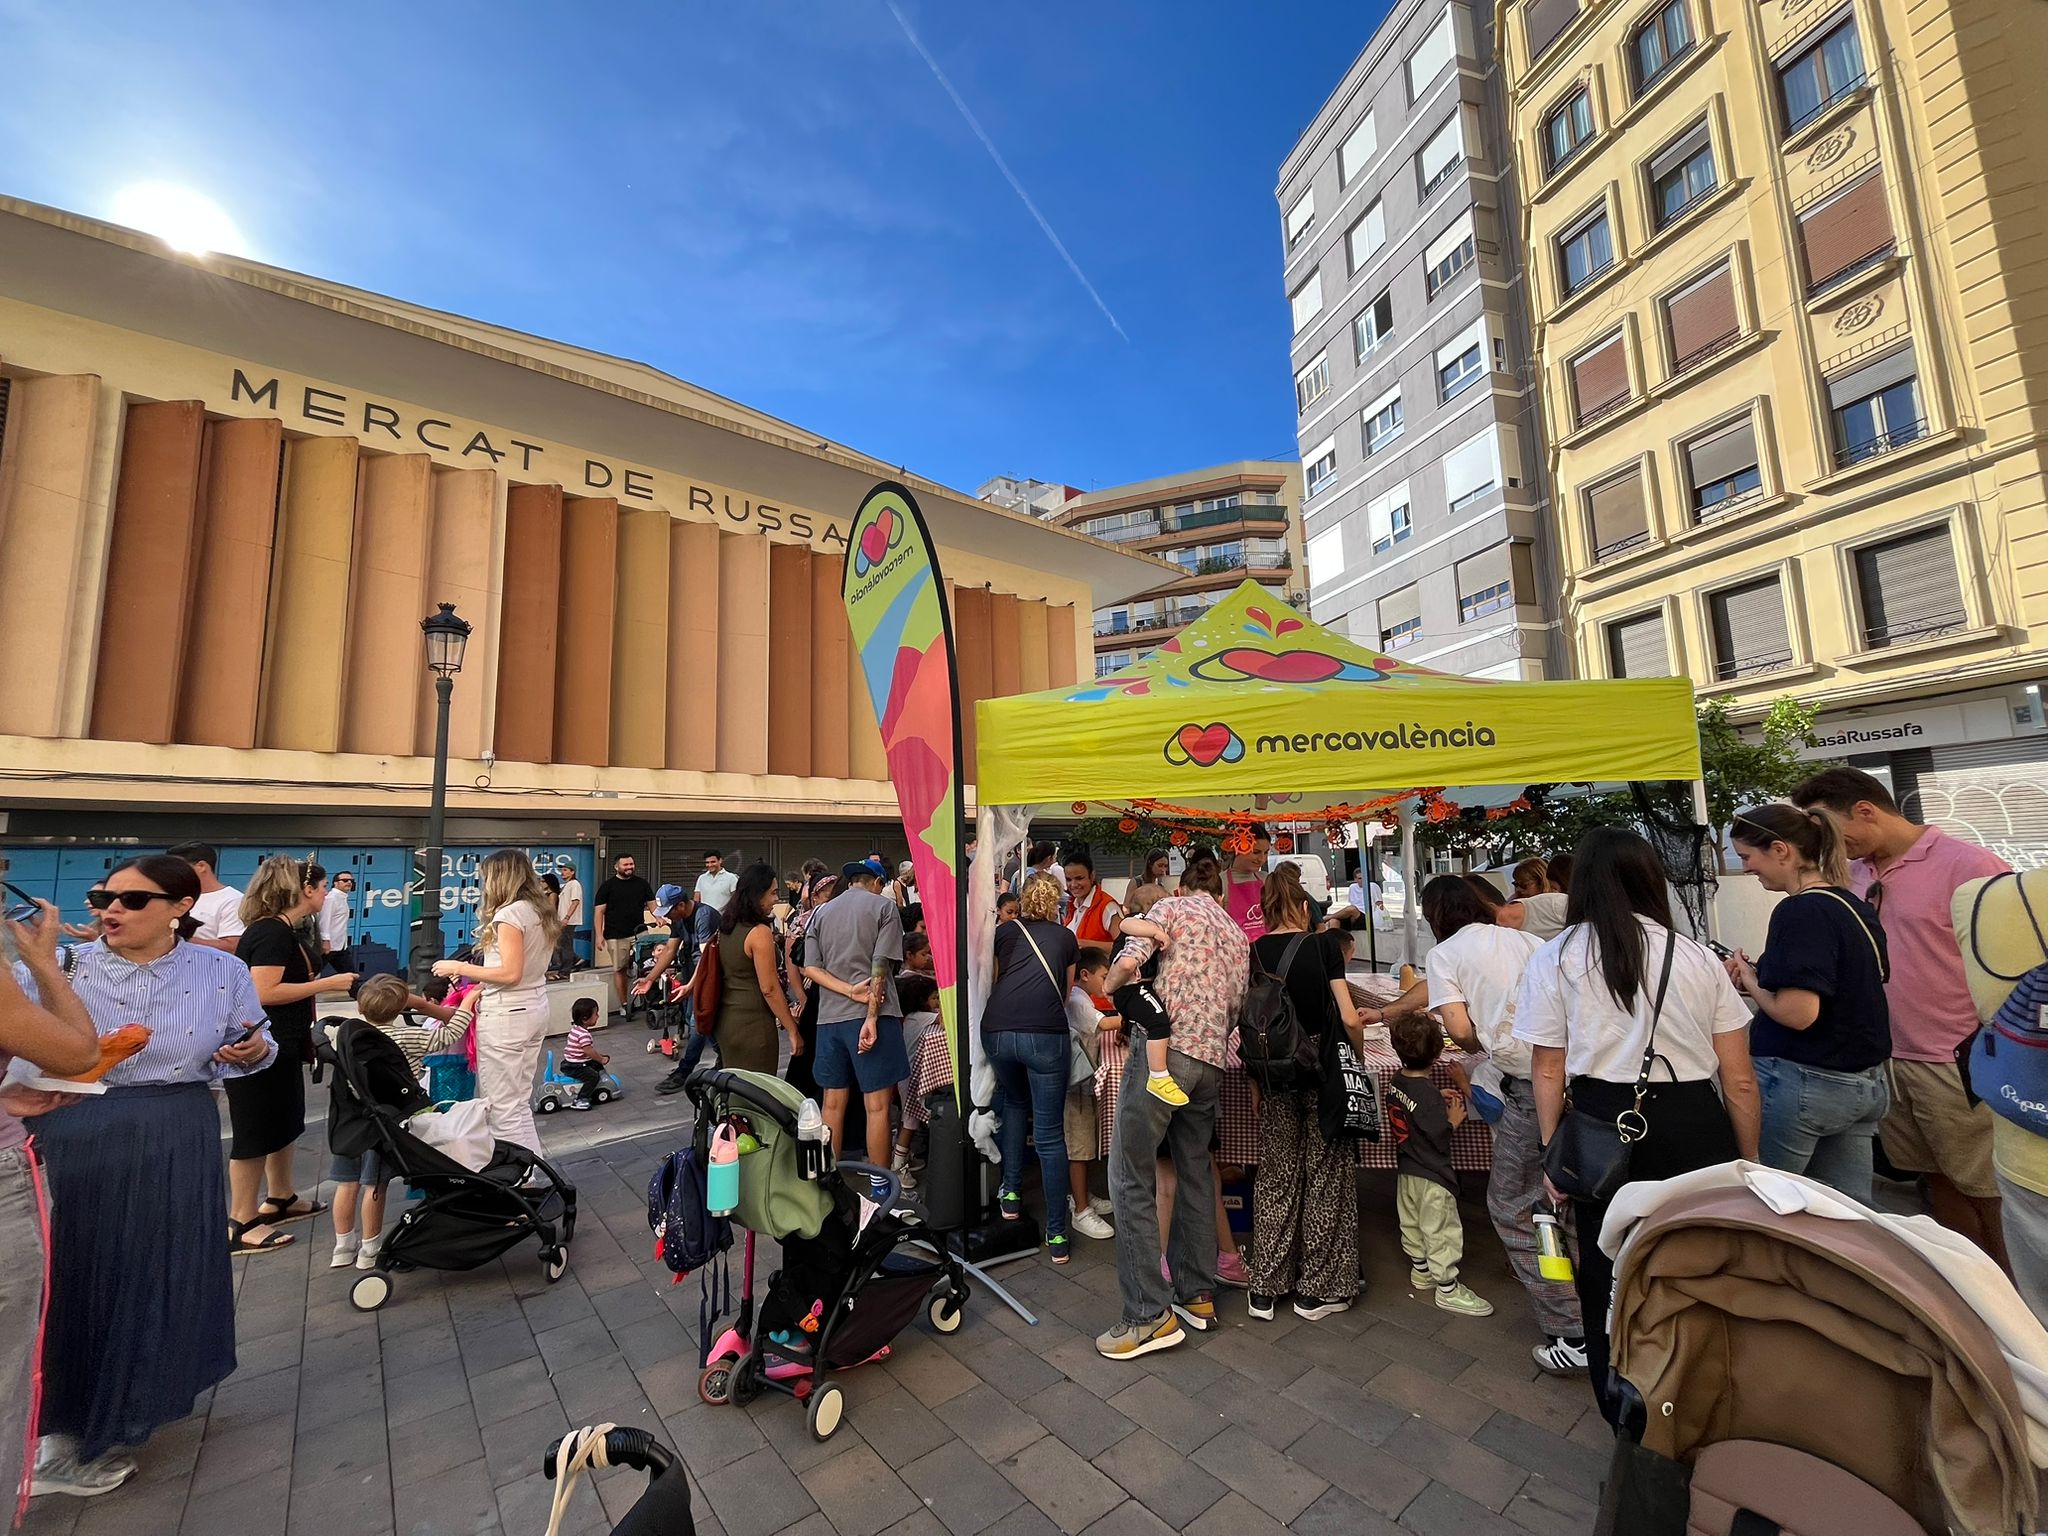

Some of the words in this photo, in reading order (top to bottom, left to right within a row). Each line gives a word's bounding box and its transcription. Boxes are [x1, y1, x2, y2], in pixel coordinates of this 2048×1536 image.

[231, 368, 544, 472] MERCAT
[584, 460, 654, 501] DE
[1256, 720, 1496, 753] mercavalència
[1805, 722, 1923, 749] asaRussafa
